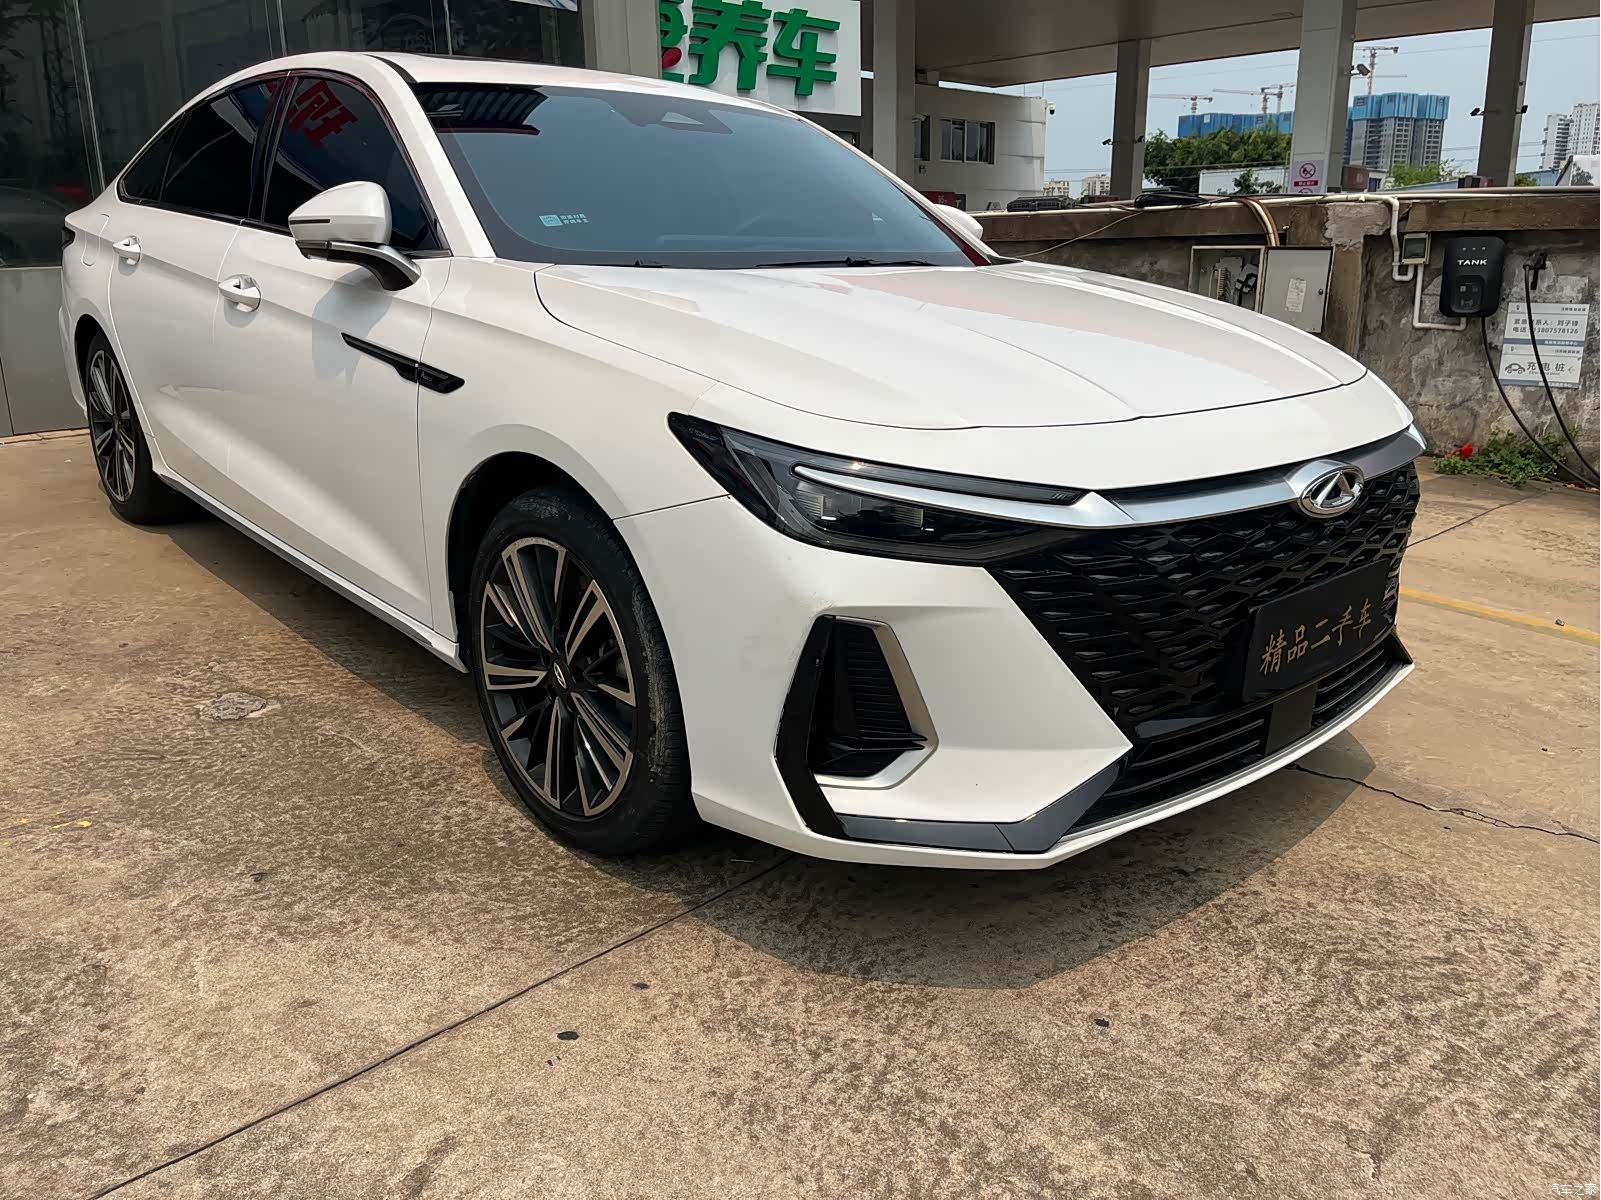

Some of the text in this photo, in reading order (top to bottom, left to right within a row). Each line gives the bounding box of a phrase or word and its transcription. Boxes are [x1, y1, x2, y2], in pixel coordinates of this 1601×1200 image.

[1259, 598, 1372, 675] 精品二手车
